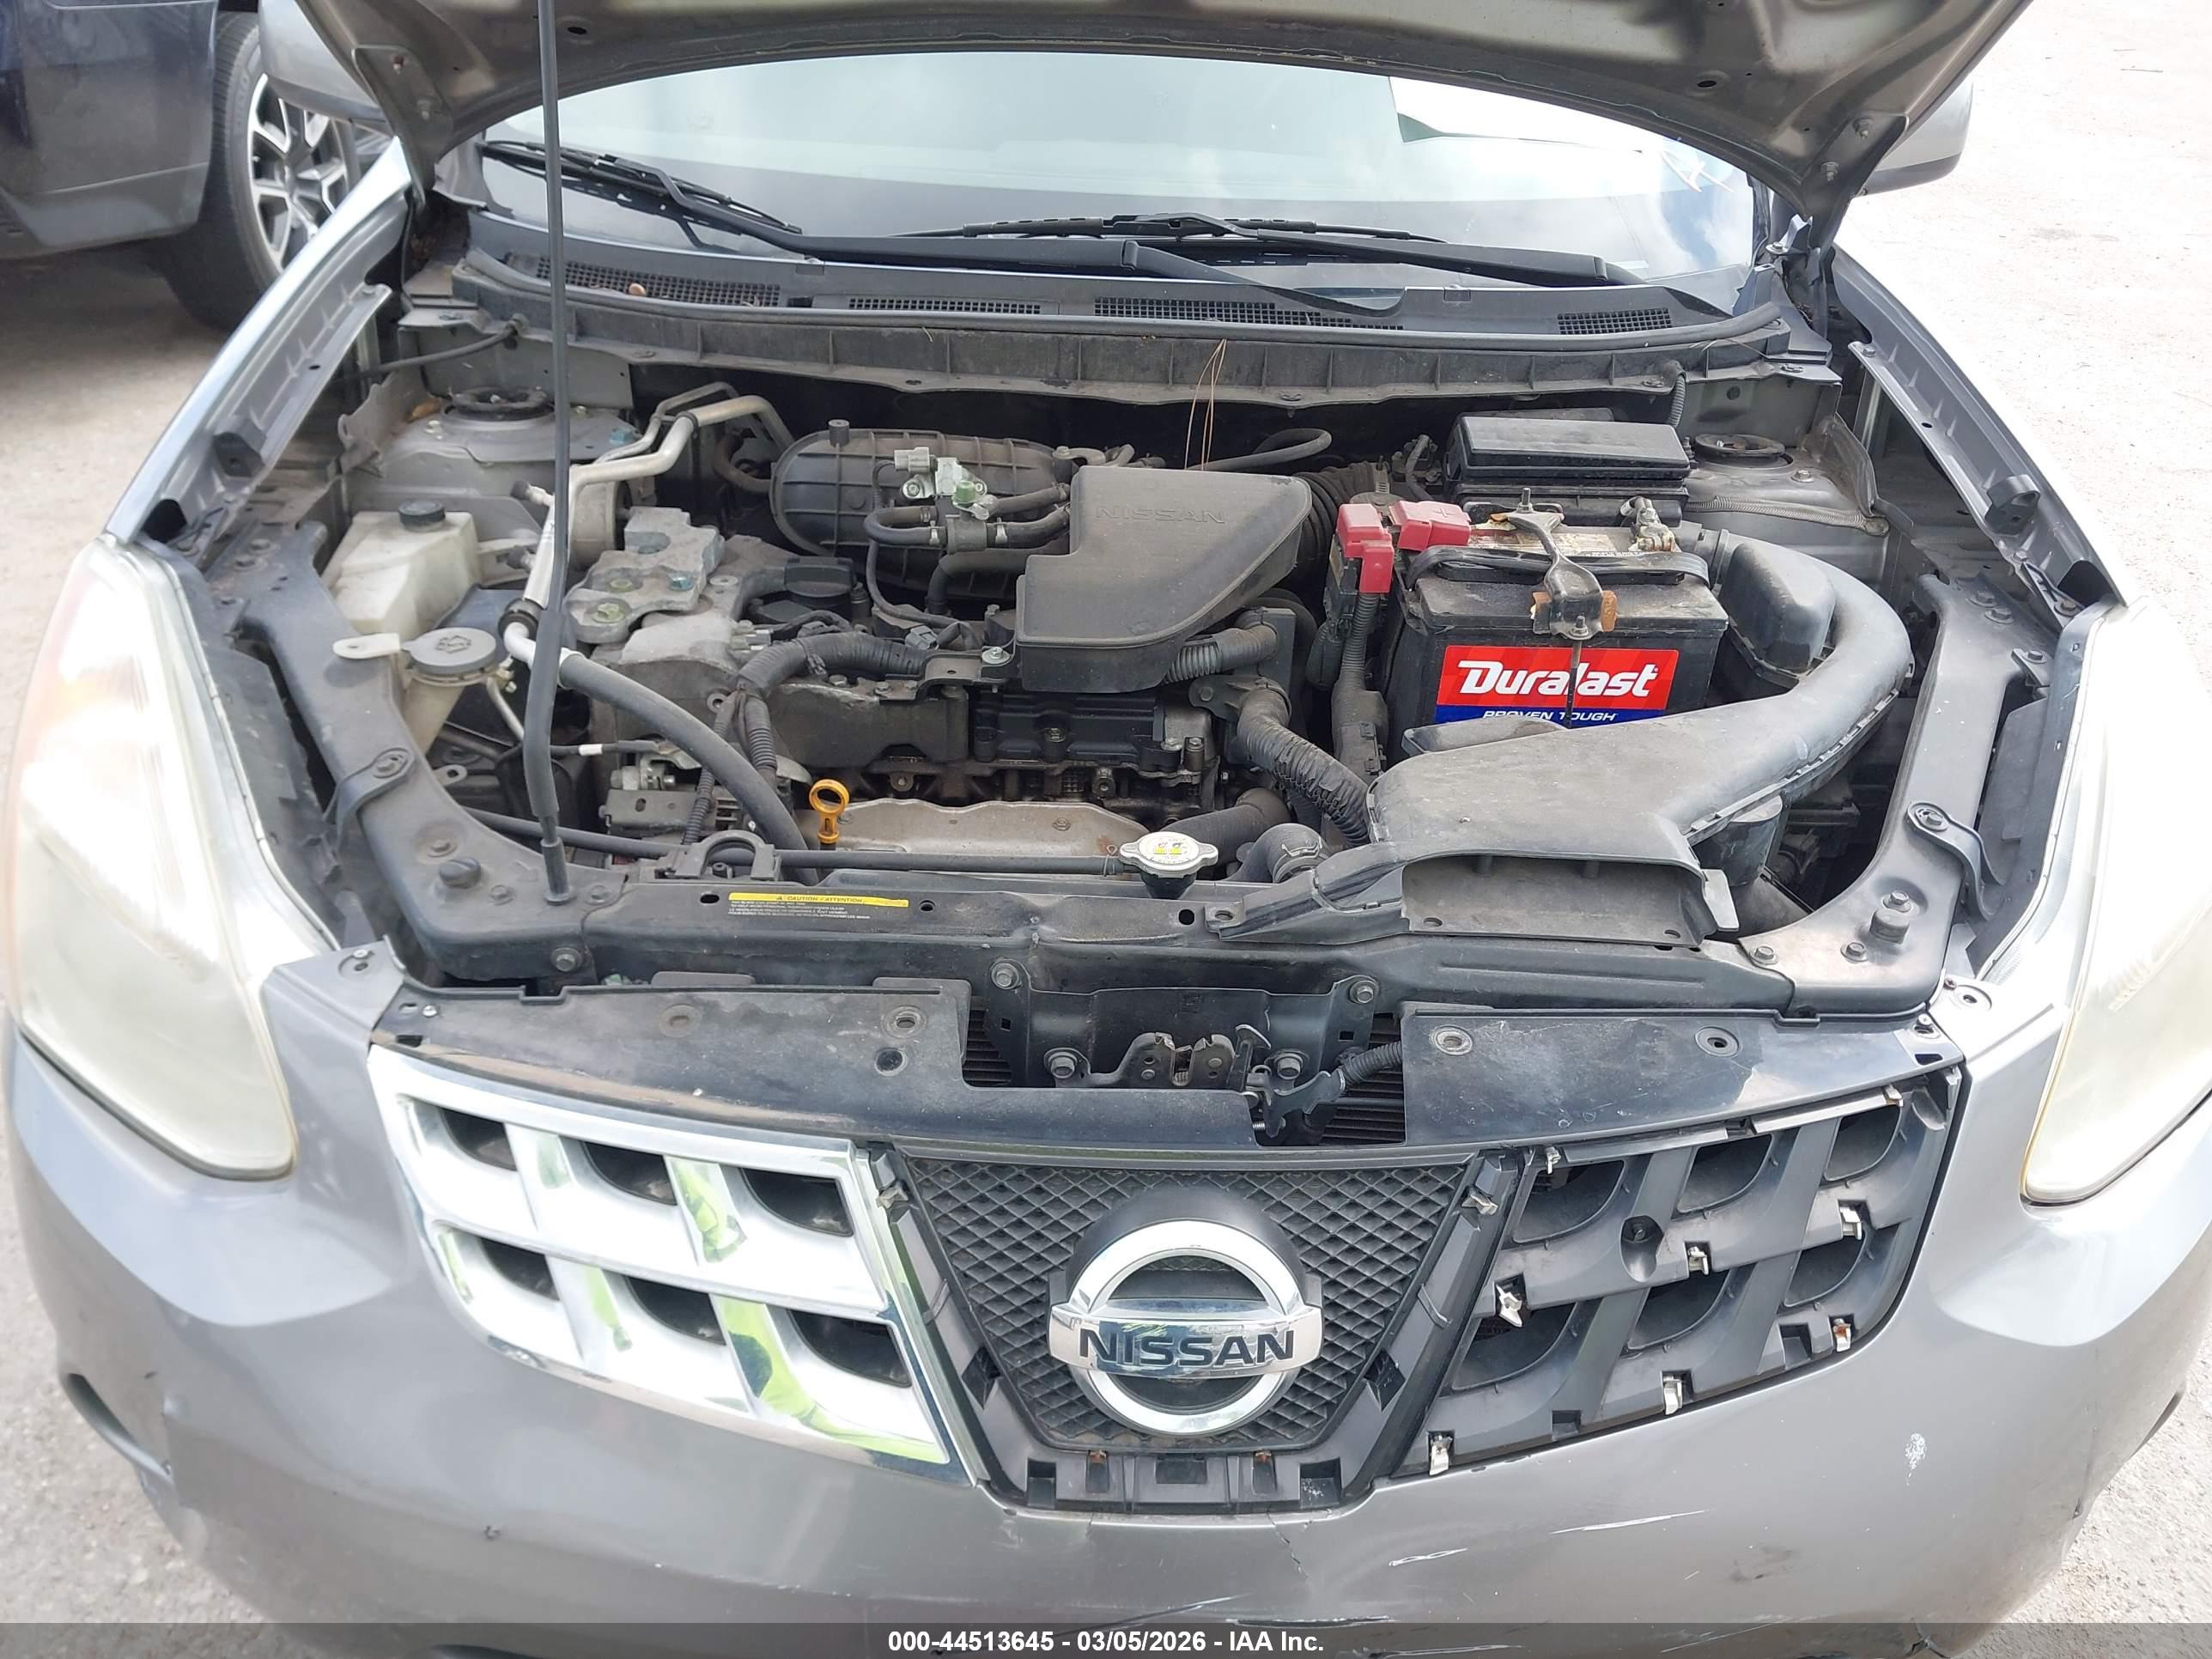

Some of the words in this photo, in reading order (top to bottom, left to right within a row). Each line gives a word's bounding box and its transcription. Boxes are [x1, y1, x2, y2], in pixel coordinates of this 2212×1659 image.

[1097, 505, 1225, 524] NISSAN
[1458, 659, 1658, 697] Duralast
[1559, 712, 1617, 721] TOUGH
[1079, 1328, 1294, 1367] NISSAN
